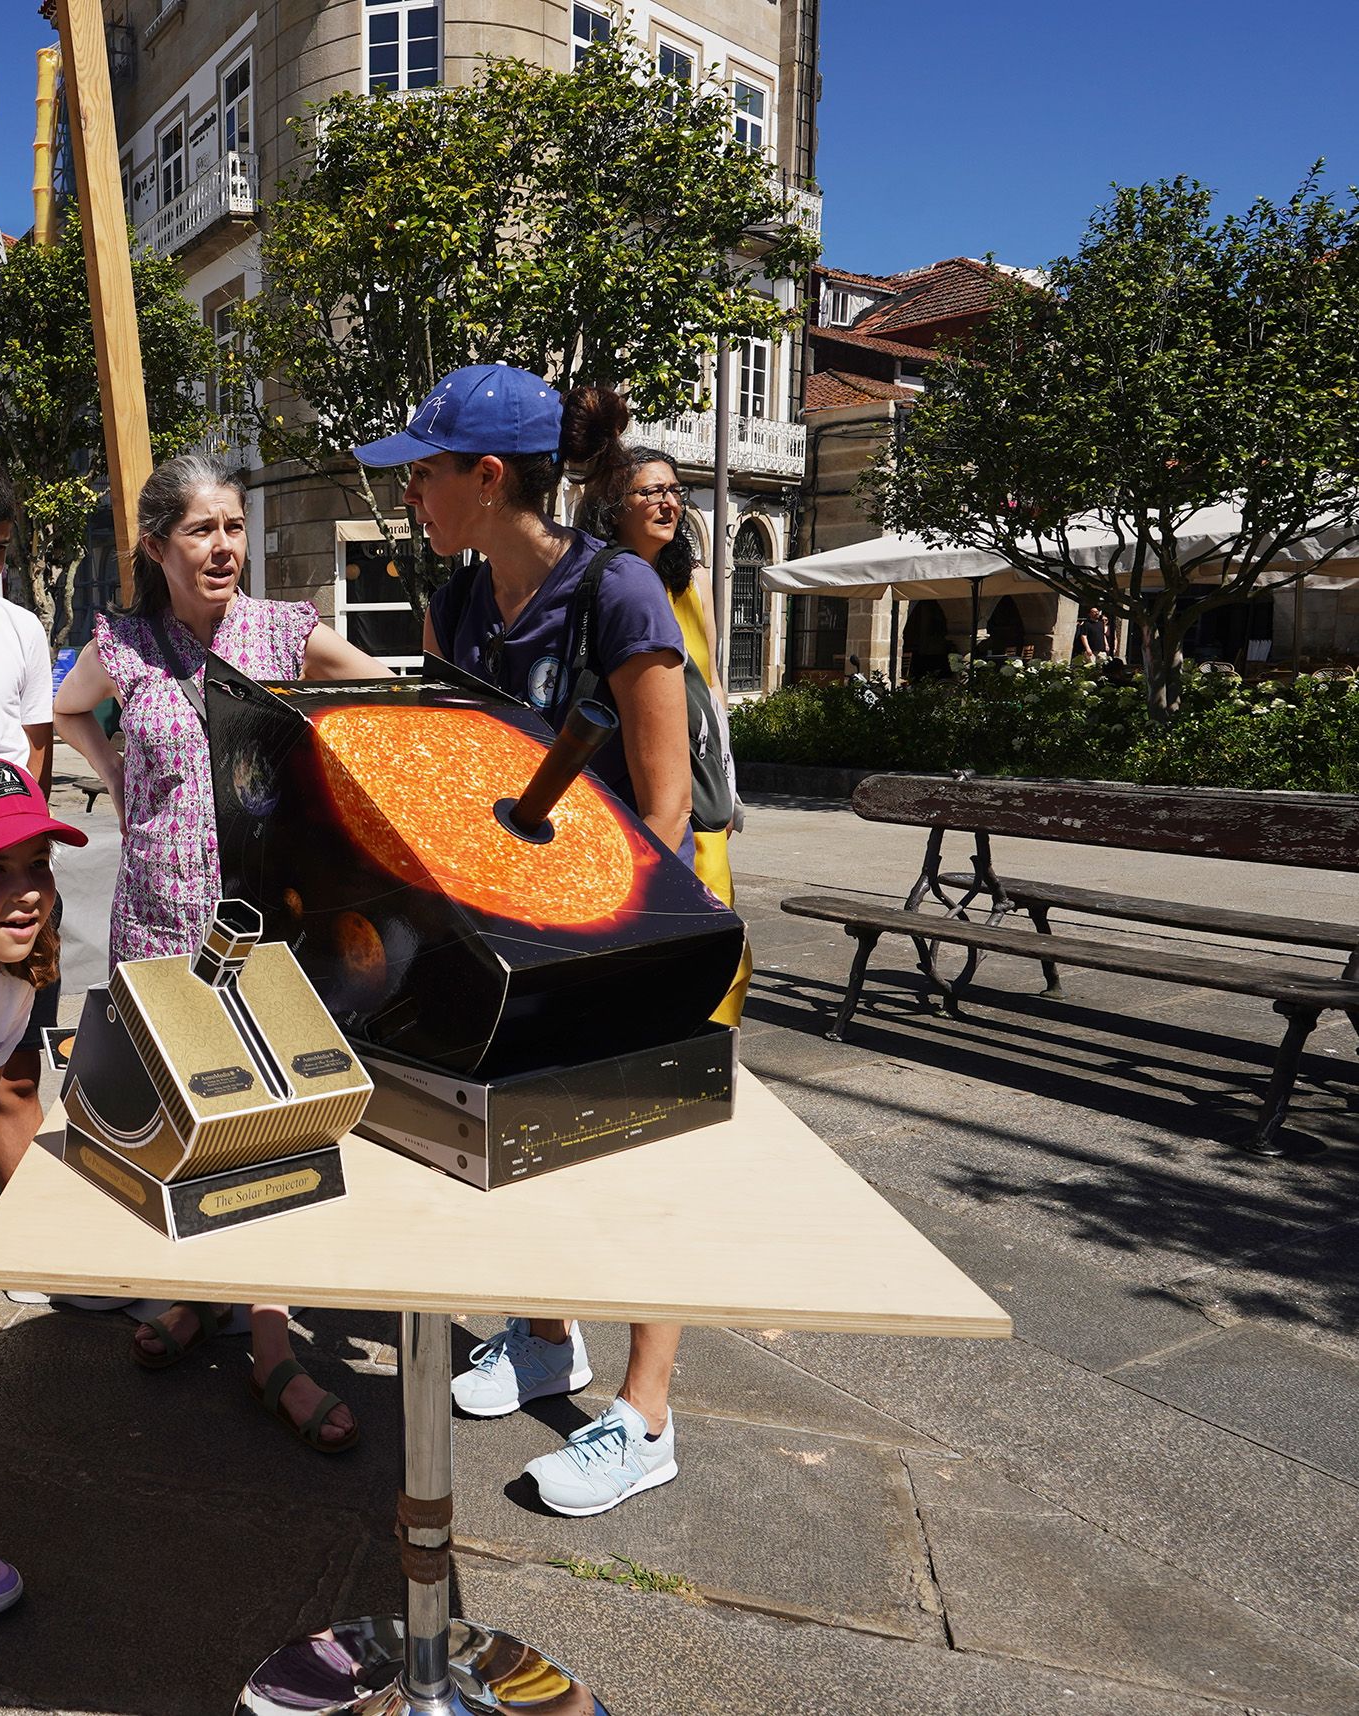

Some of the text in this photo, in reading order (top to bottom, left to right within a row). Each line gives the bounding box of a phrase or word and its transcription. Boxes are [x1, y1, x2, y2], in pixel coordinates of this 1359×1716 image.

[214, 1177, 309, 1208] The Solar Projector
